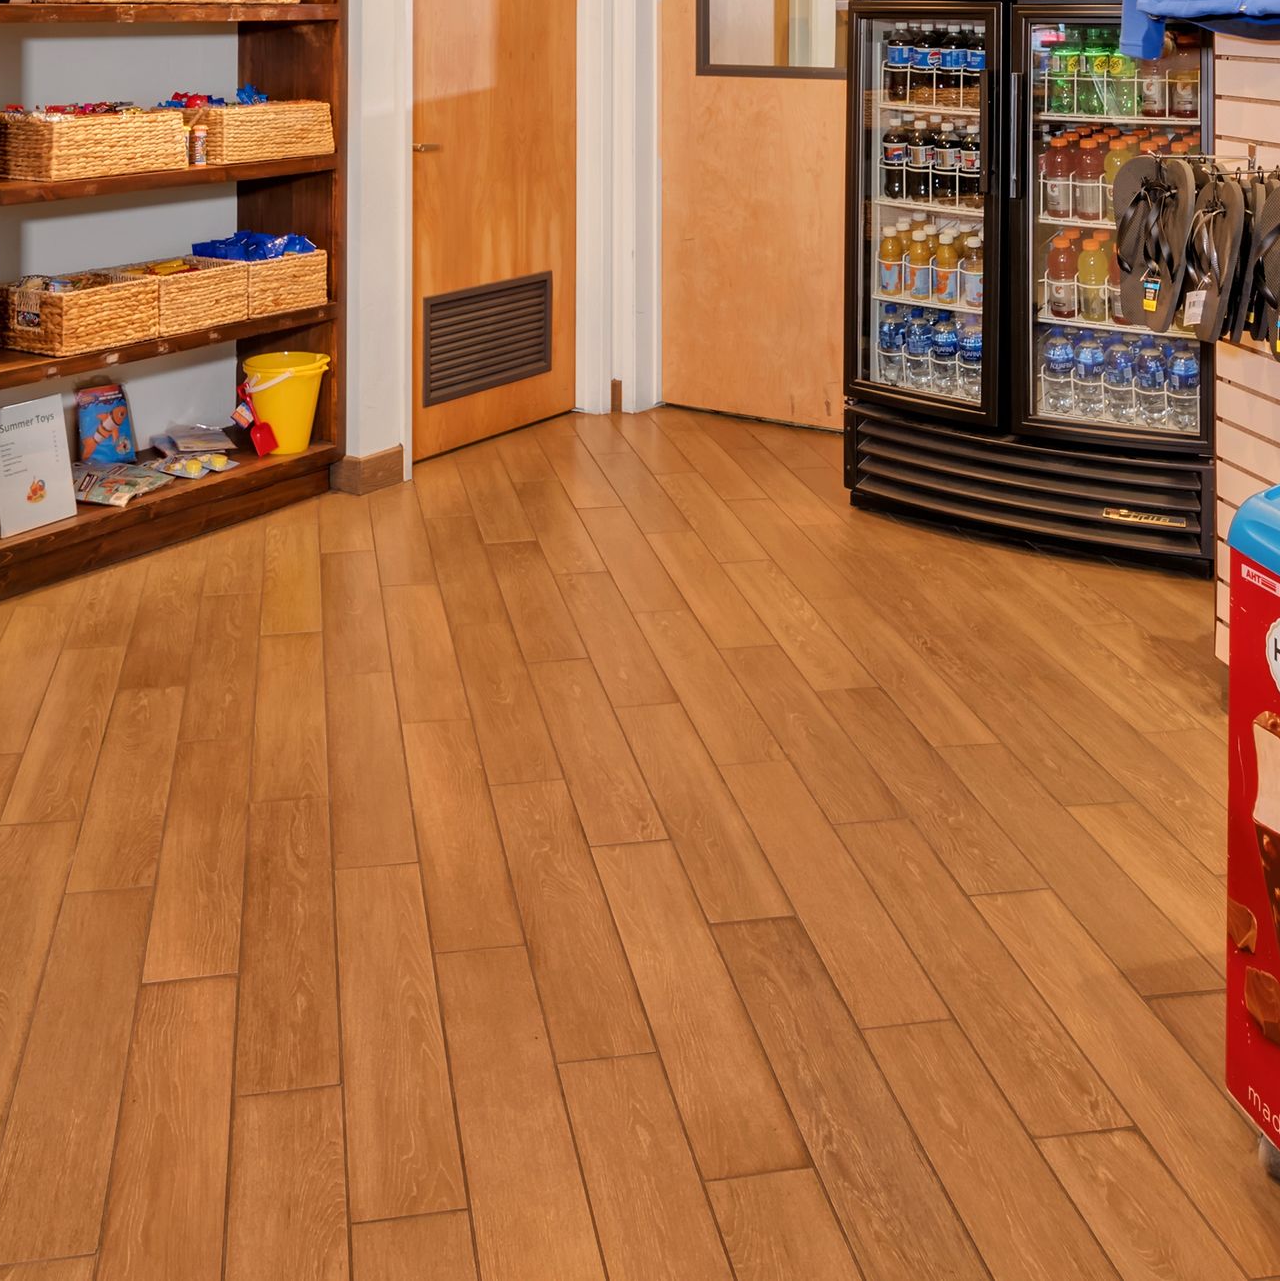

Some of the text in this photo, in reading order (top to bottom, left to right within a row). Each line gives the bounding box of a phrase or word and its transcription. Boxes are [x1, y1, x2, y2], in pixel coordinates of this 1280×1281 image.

[0, 413, 54, 434] Summer Toys
[1245, 569, 1263, 584] AHT
